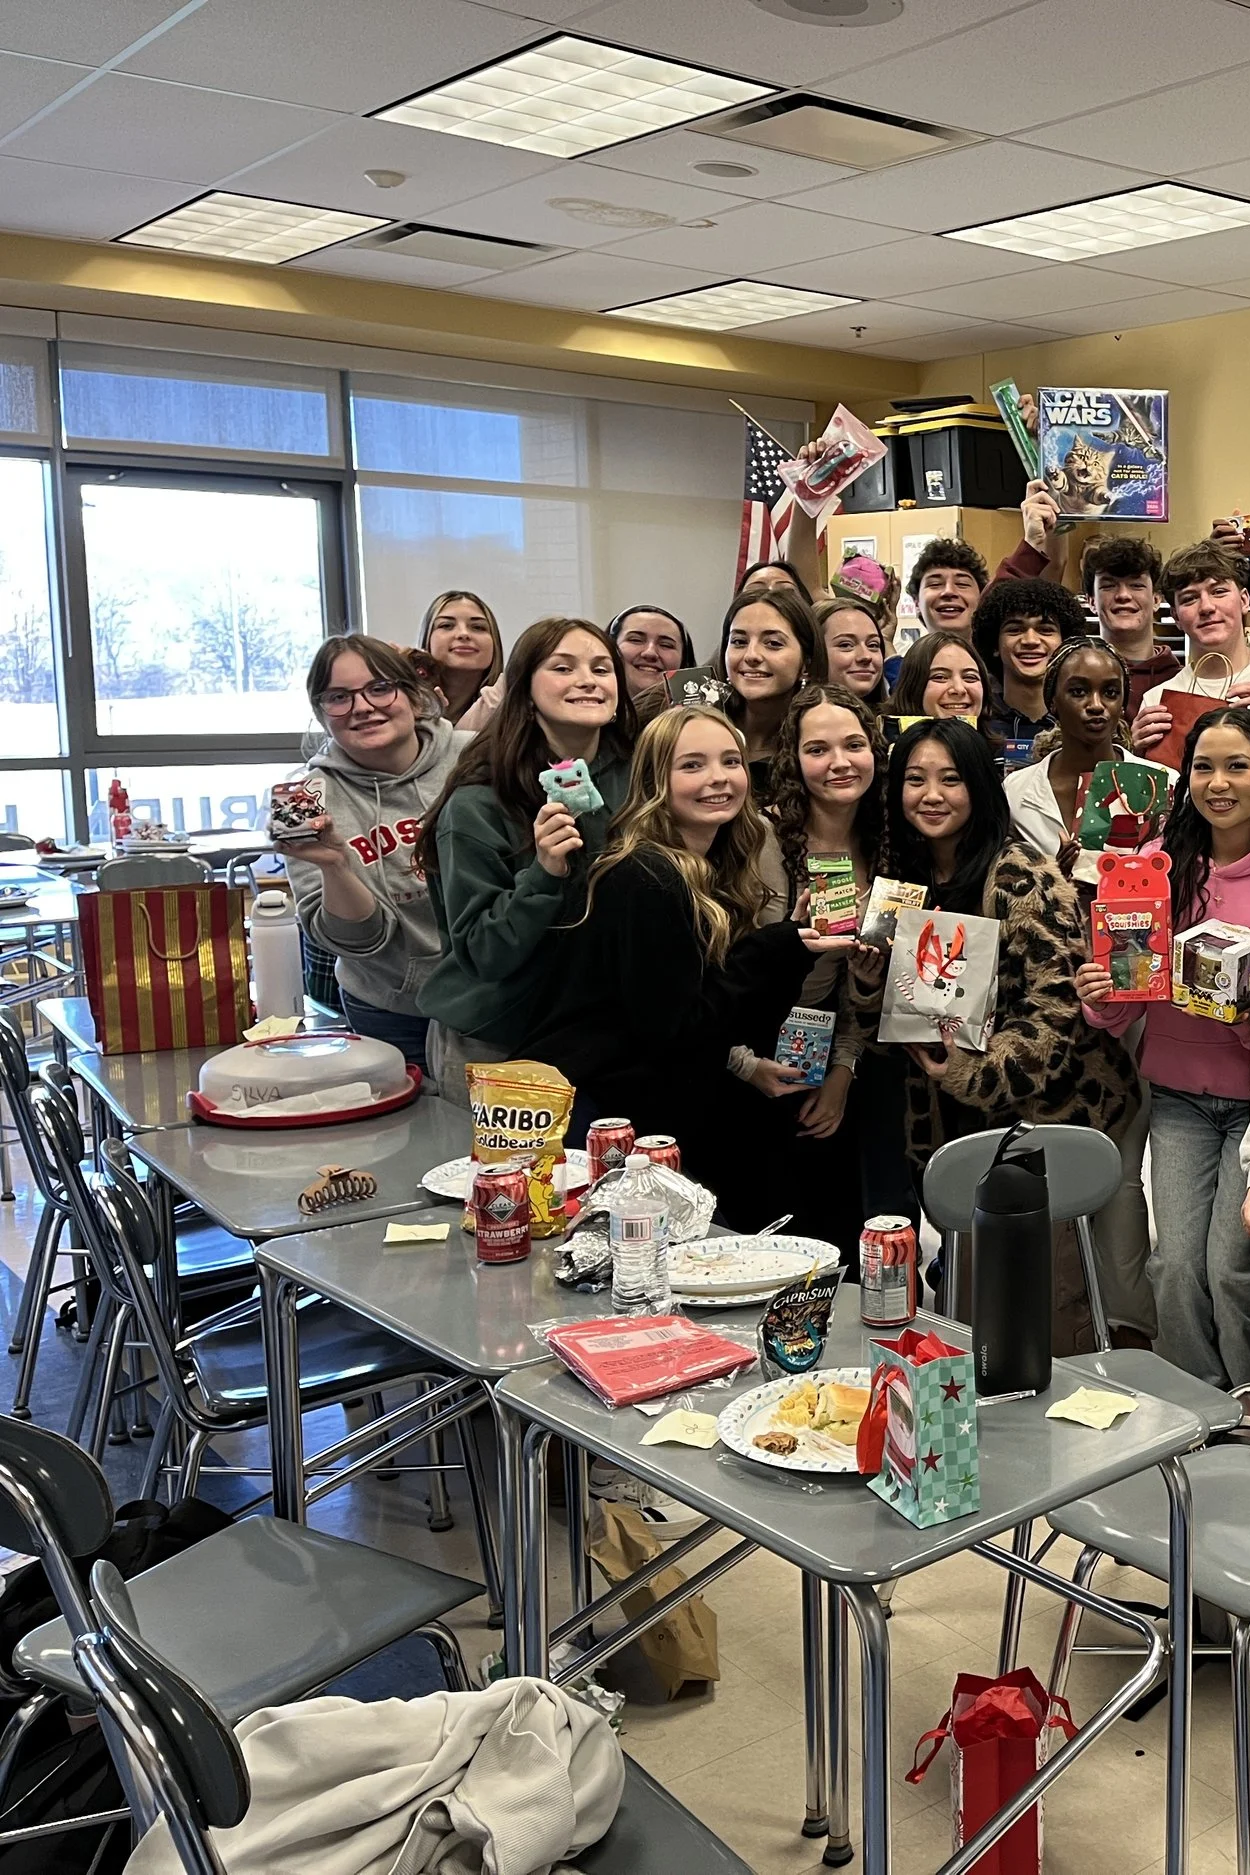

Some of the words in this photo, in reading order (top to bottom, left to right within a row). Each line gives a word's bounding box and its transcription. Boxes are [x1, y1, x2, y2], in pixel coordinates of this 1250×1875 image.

[1045, 391, 1111, 408] CAT
[1045, 408, 1112, 425] WARS
[832, 876, 853, 886] MOOSE
[834, 888, 853, 896] MATCH
[830, 898, 854, 908] MAYHEM
[231, 1084, 282, 1102] SILVA
